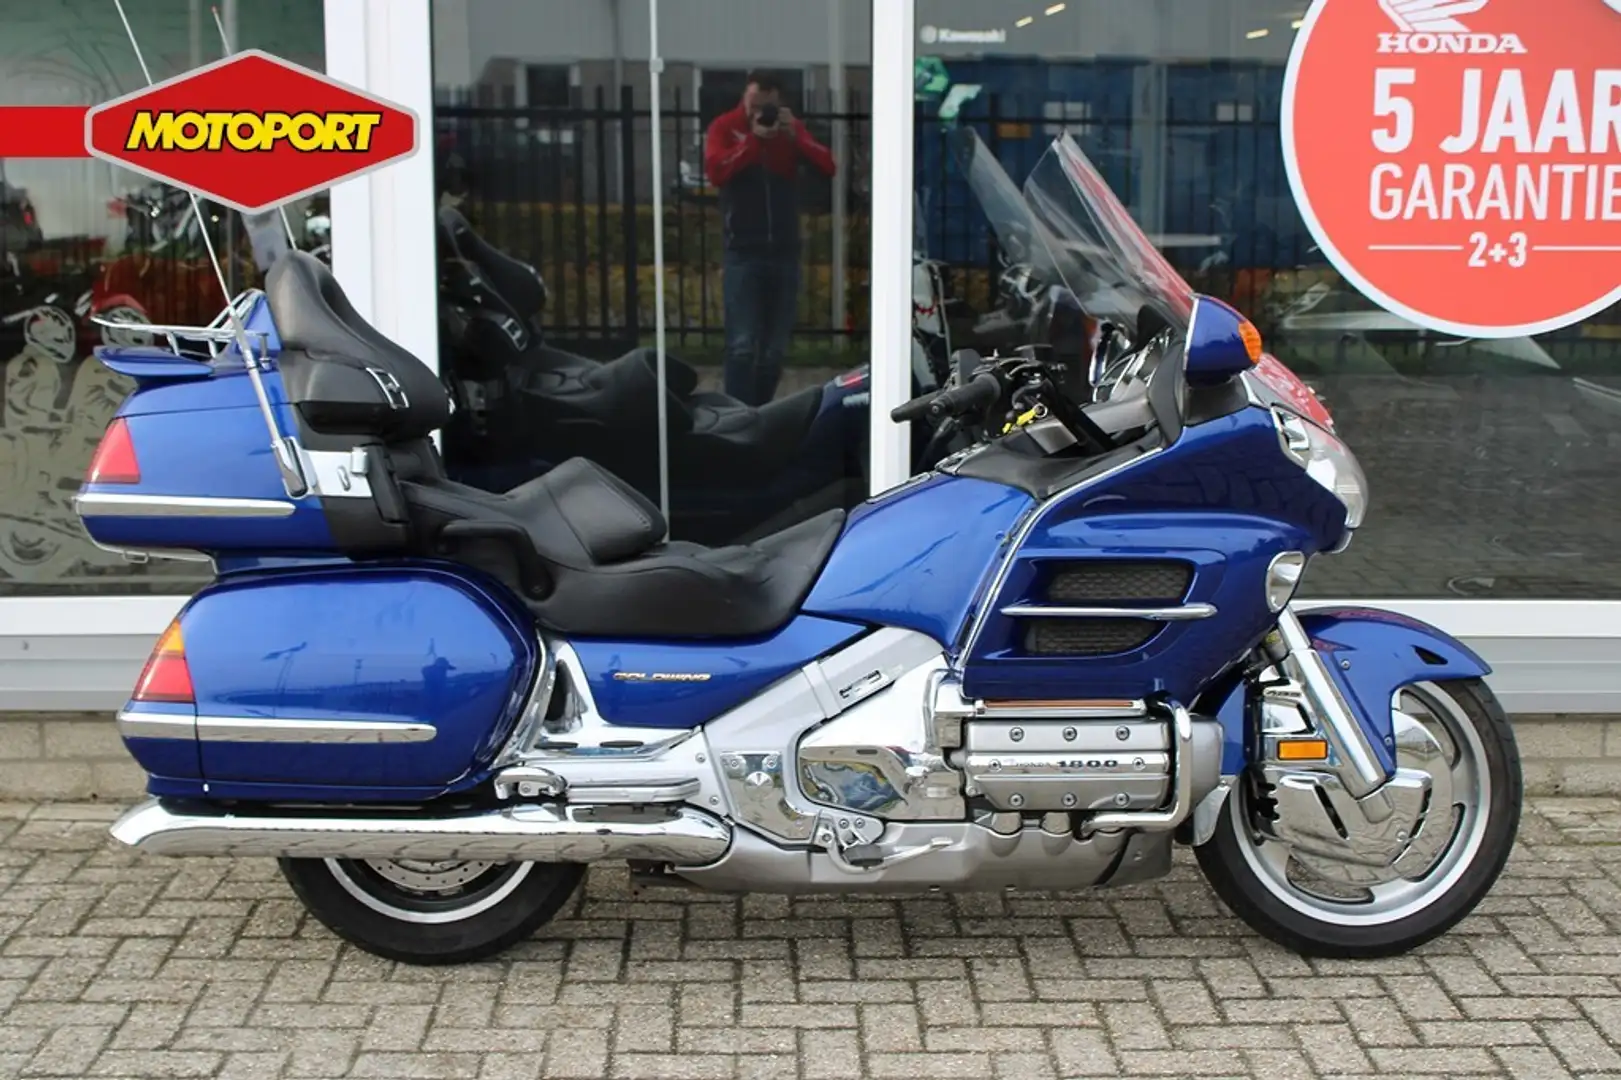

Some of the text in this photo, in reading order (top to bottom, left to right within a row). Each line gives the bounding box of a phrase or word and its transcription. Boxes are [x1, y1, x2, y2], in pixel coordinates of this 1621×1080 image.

[1375, 32, 1528, 54] HONDA
[1371, 67, 1621, 153] 5 JAAR
[1368, 162, 1621, 221] GARANTIE
[1467, 231, 1528, 268] 2+3
[1055, 759, 1119, 769] 1800
